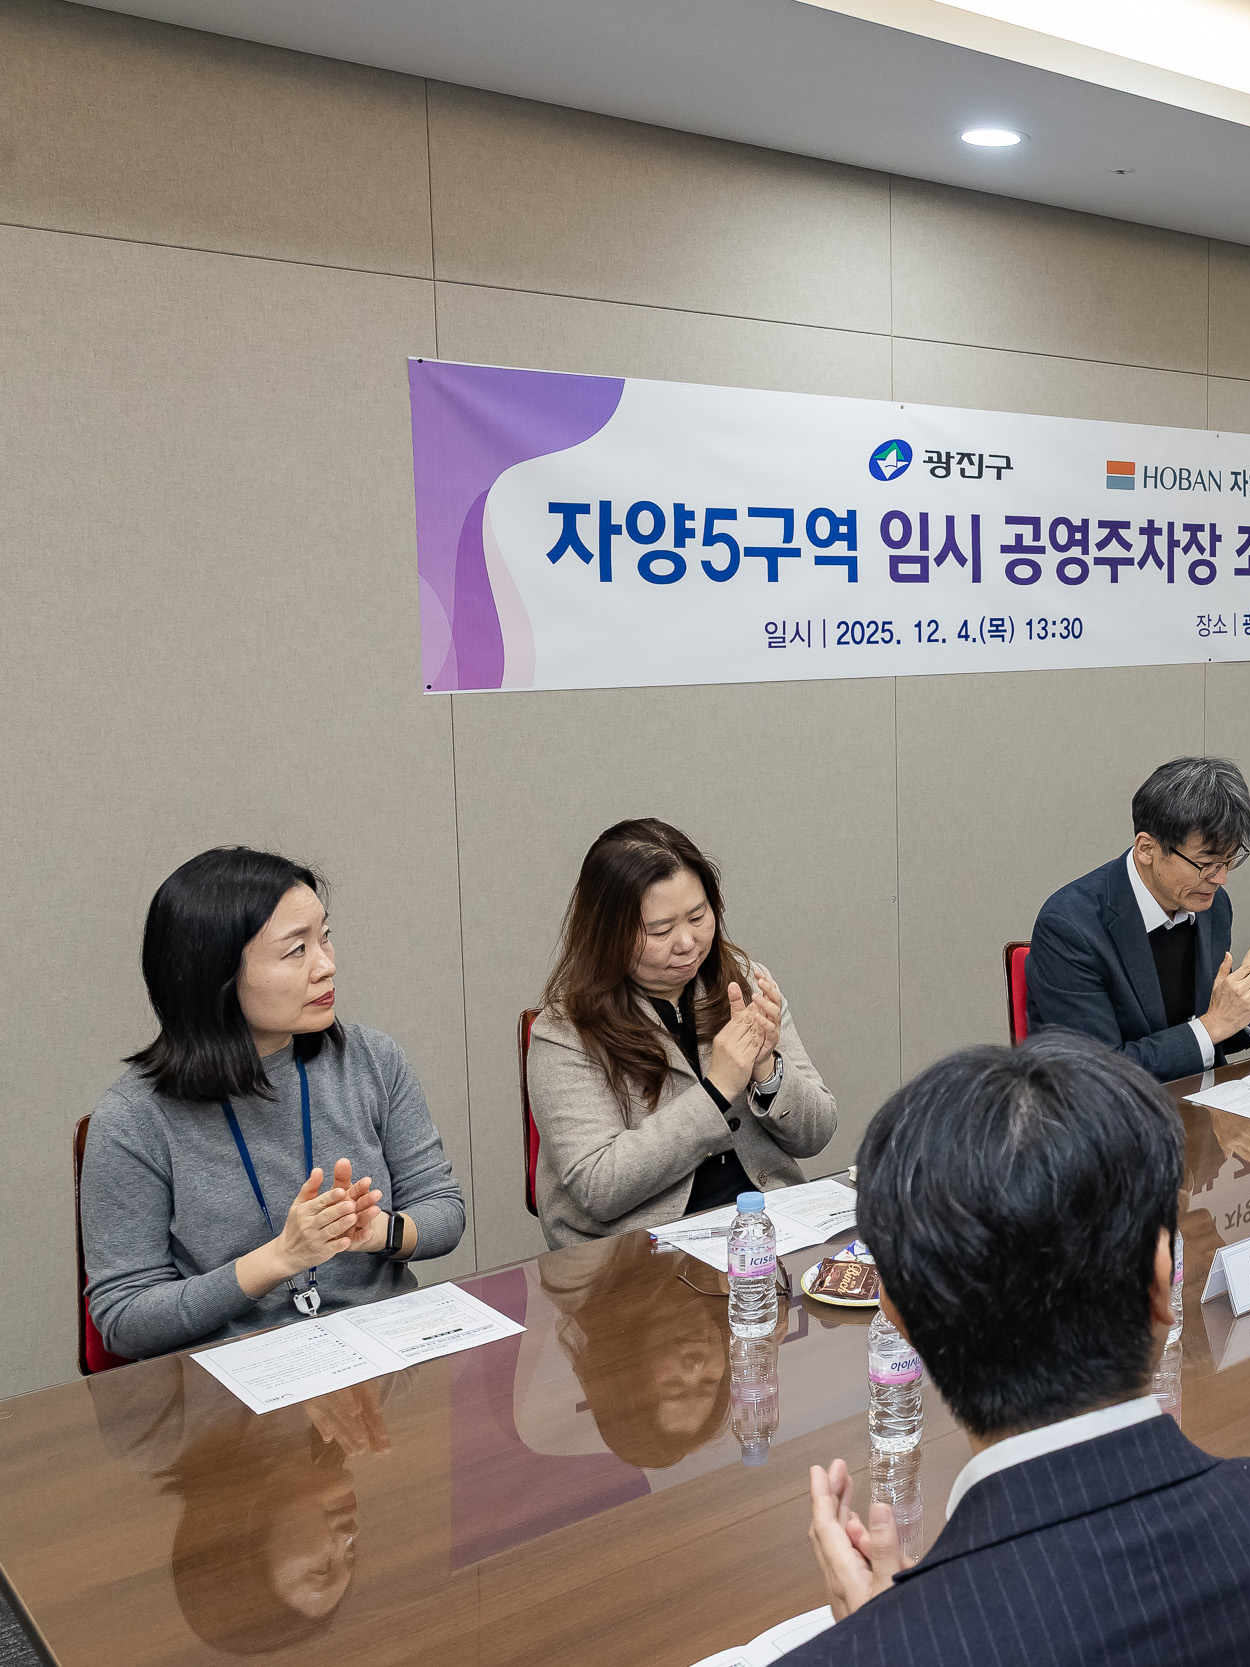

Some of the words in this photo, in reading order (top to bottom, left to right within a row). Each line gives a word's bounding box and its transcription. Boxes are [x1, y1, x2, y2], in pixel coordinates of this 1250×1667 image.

[923, 450, 1013, 481] 광진구
[1143, 465, 1222, 493] HOBAN
[546, 499, 859, 586] 자양5구역
[879, 509, 983, 584] 임시
[999, 515, 1223, 586] 공영주차장
[764, 619, 812, 649] 일시
[836, 620, 902, 646] 2025.
[913, 619, 947, 644] 12.
[1025, 617, 1084, 641] 13:30
[1195, 613, 1228, 638] 장소
[837, 1263, 862, 1295] Binch
